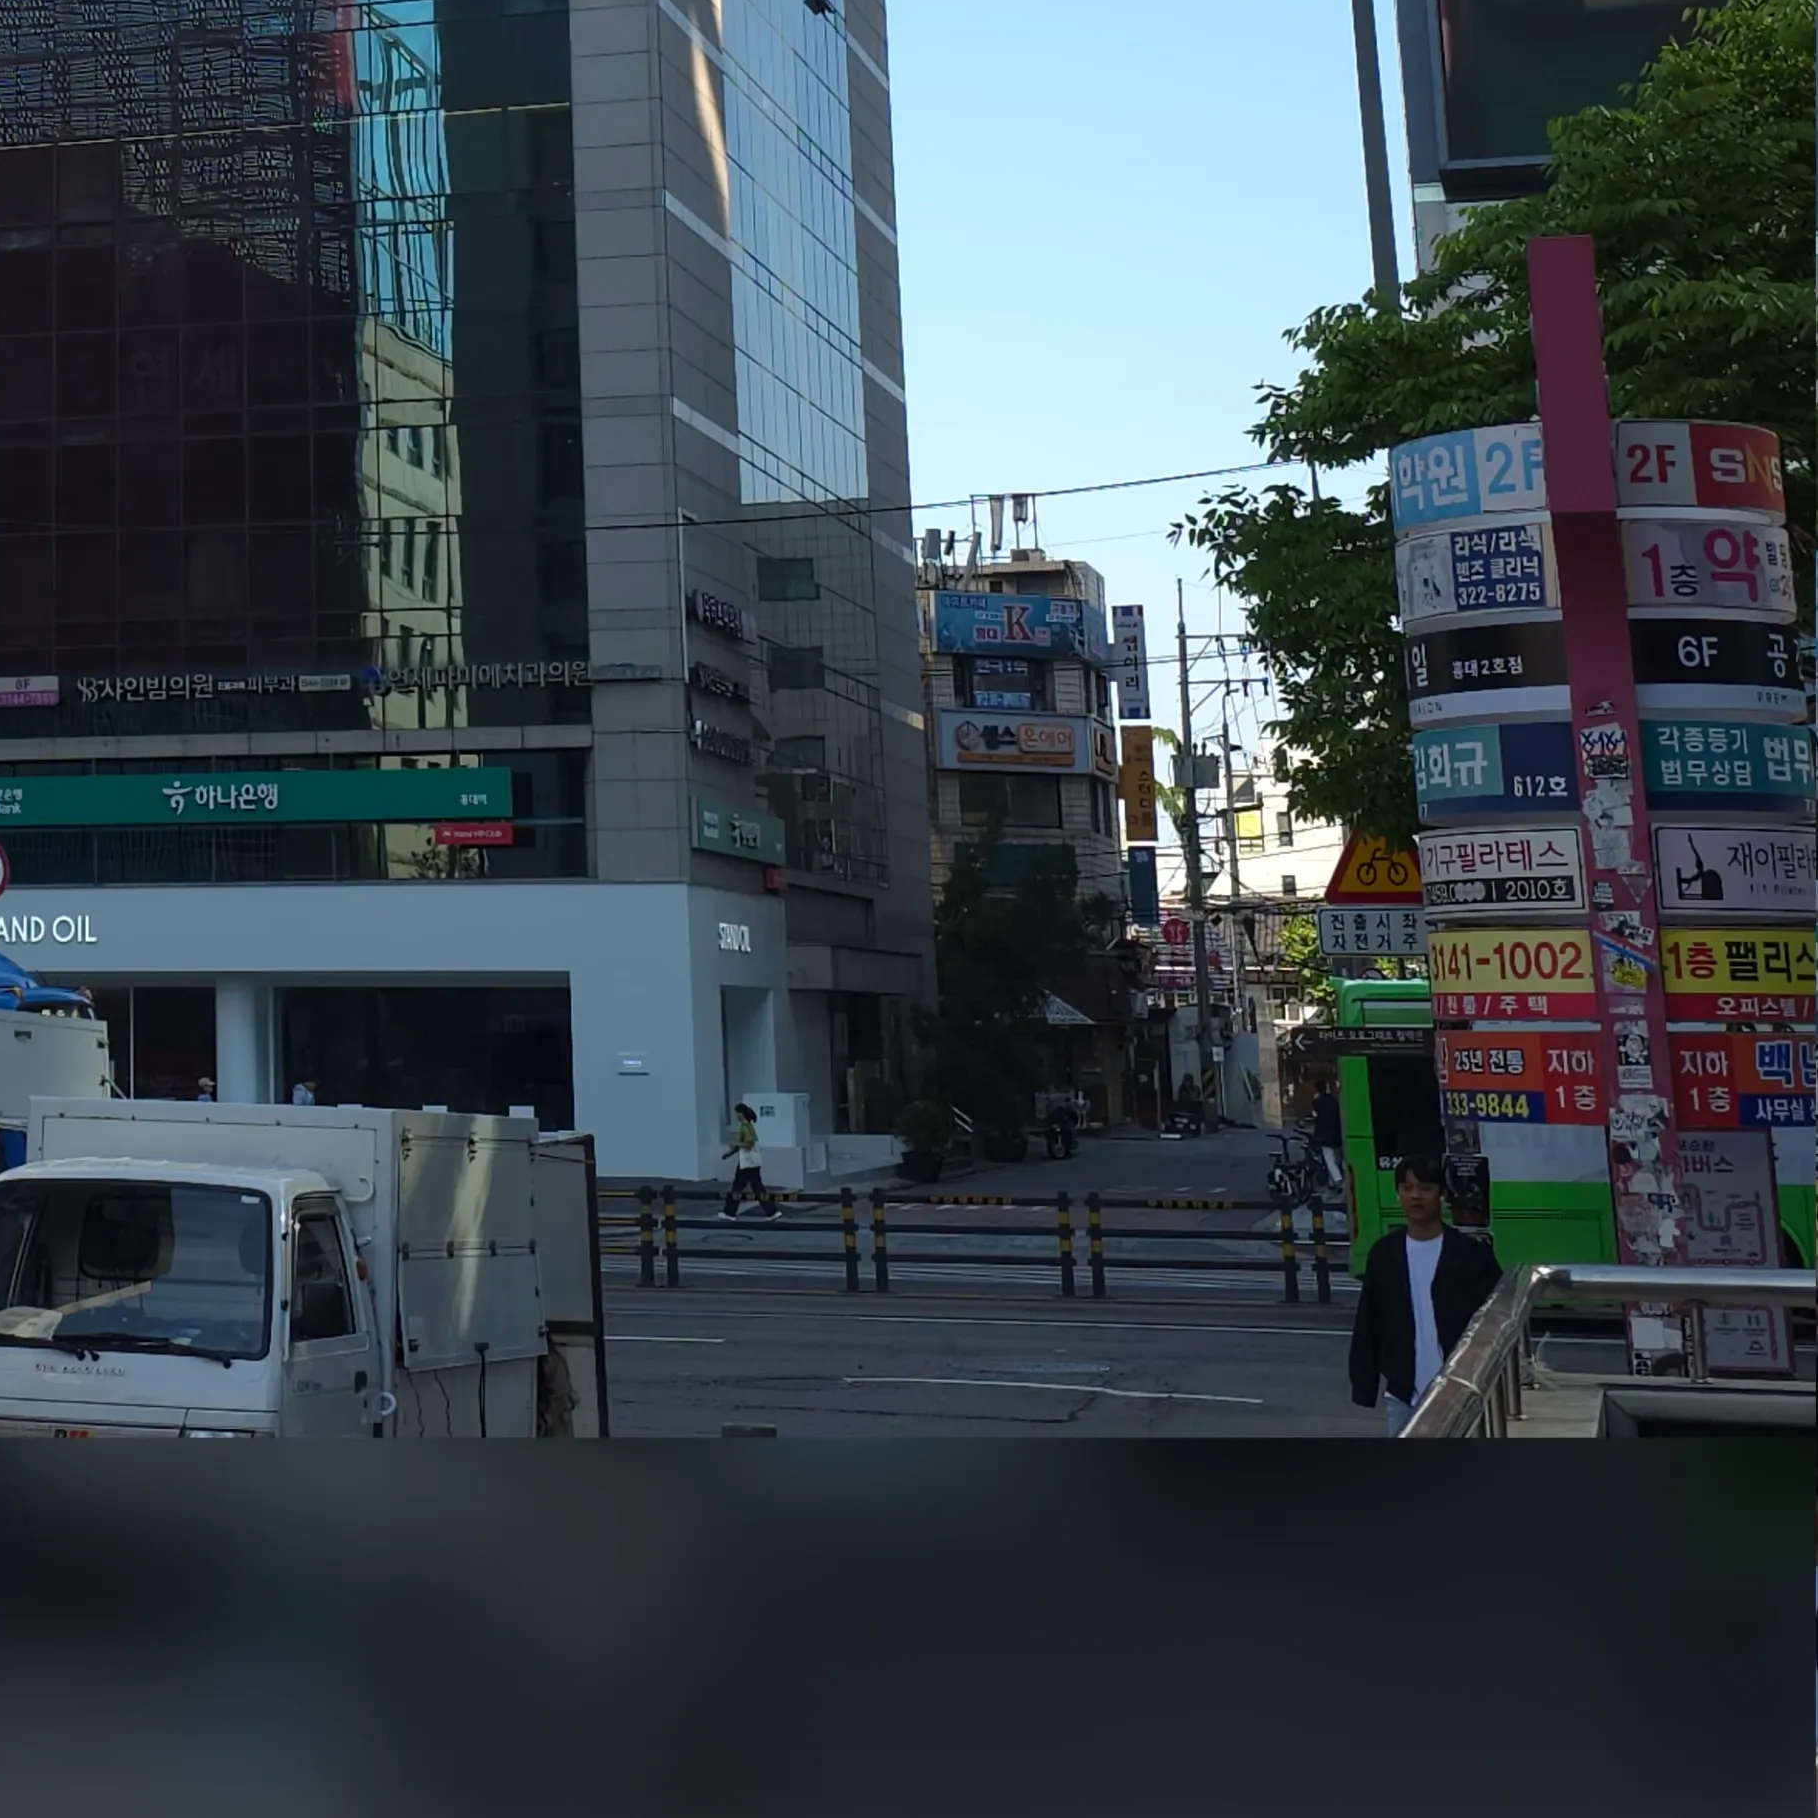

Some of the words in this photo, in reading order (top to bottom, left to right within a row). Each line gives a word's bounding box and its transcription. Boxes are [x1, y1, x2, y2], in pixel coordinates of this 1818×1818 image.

[1485, 438, 1543, 495] 2F
[1627, 443, 1675, 484] 2F
[1456, 559, 1486, 583] 렌즈
[1490, 555, 1540, 580] 클리닉
[1704, 528, 1761, 603] 약
[1457, 582, 1540, 606] 322-8275
[1004, 604, 1033, 642] K
[1677, 635, 1719, 668] 6F
[1766, 633, 1789, 678] 공
[101, 673, 214, 701] 샤인빔의원
[247, 675, 295, 694] 피부과
[1657, 726, 1749, 755] 각종등기
[1660, 759, 1752, 786] 법무상담
[1763, 736, 1812, 785] 법무
[194, 782, 278, 810] 하나은행
[1513, 775, 1568, 797] 612호
[1505, 878, 1572, 901] 2010호
[52, 914, 98, 943] OIL
[1331, 933, 1392, 951] 자전거
[1402, 933, 1419, 950] 주
[1432, 941, 1585, 980] 3141-1002
[1667, 941, 1717, 980] 1층
[1725, 941, 1816, 983] 팰리스
[1715, 996, 1797, 1017] 오피스텔
[1453, 1048, 1484, 1074] 25년
[1488, 1048, 1525, 1074] 전통
[1547, 1049, 1596, 1075] 지하
[1679, 1049, 1729, 1077] 지하
[1555, 1085, 1597, 1111] 1층
[1688, 1086, 1731, 1113] 1층
[1755, 1098, 1805, 1122] 사무실
